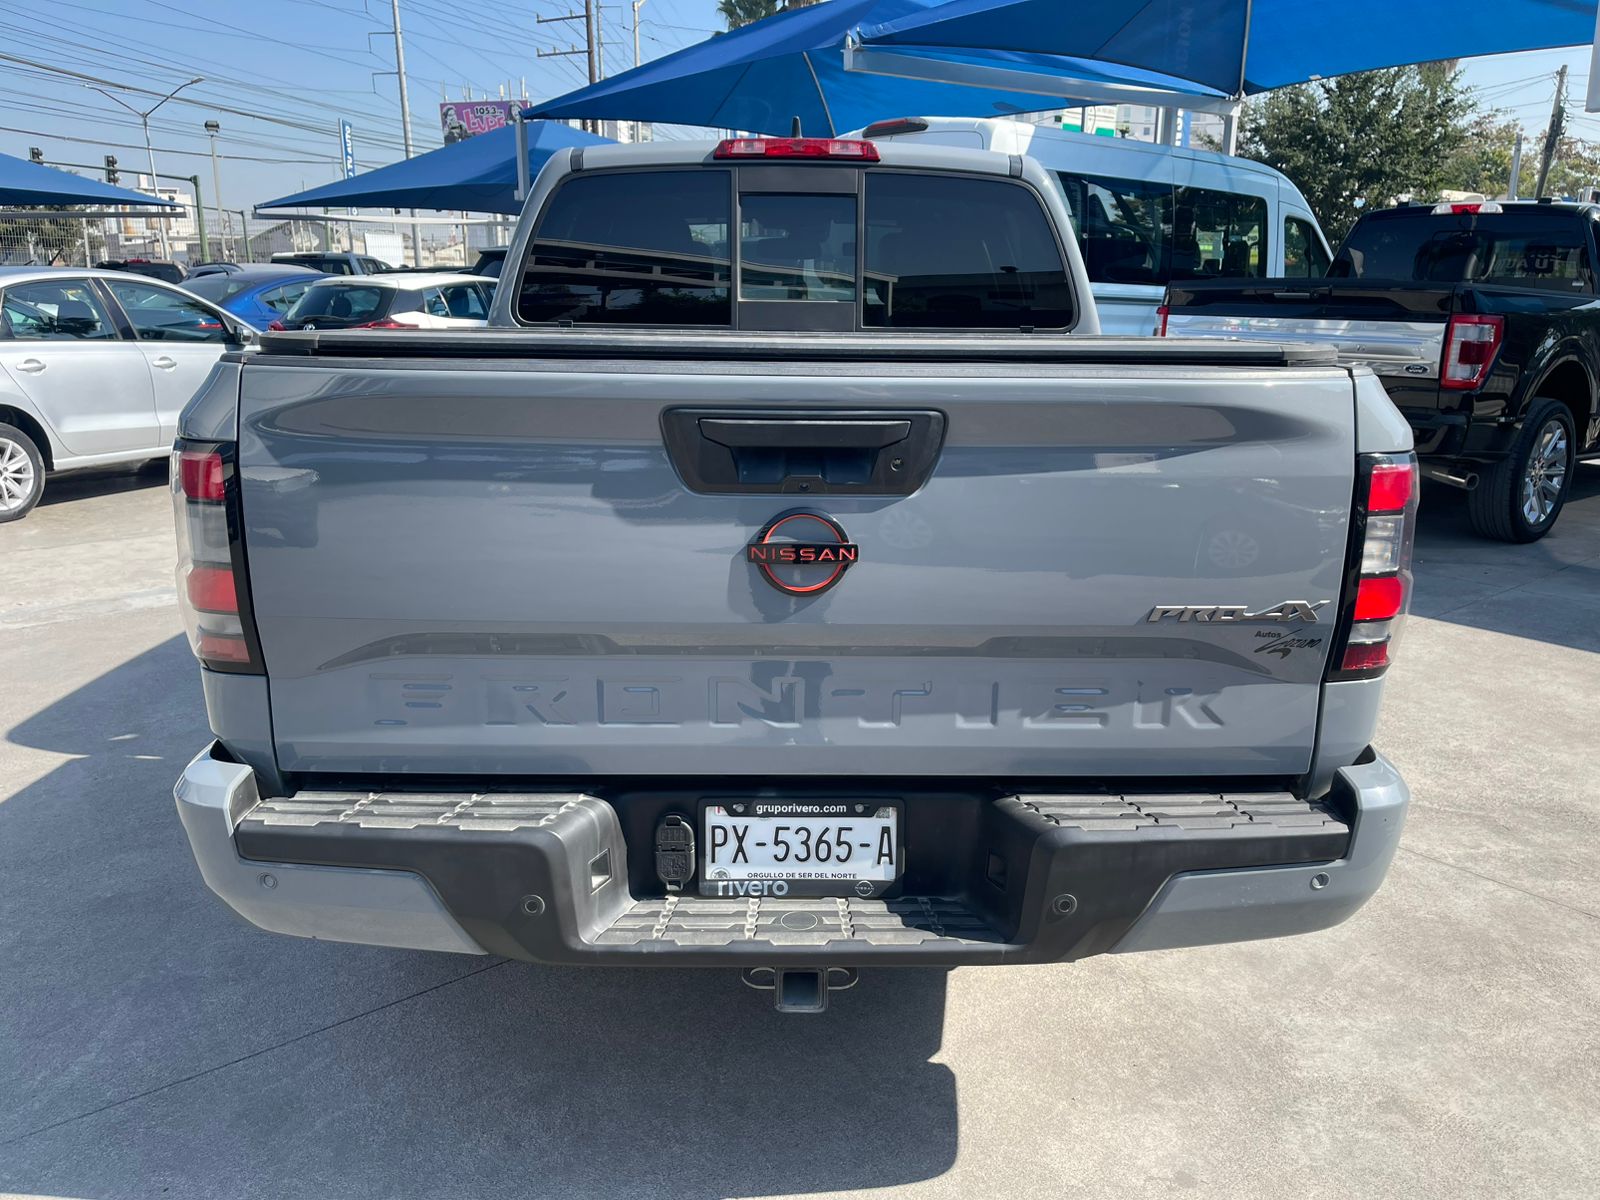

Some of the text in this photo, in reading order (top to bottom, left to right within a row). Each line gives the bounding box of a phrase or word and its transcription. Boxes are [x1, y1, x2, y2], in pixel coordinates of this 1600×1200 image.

[750, 547, 855, 561] NISSAN
[367, 673, 1225, 728] FRONTIER
[756, 803, 847, 814] gruporivero.com
[710, 824, 894, 866] PX-5365-A
[717, 880, 789, 896] rivero
